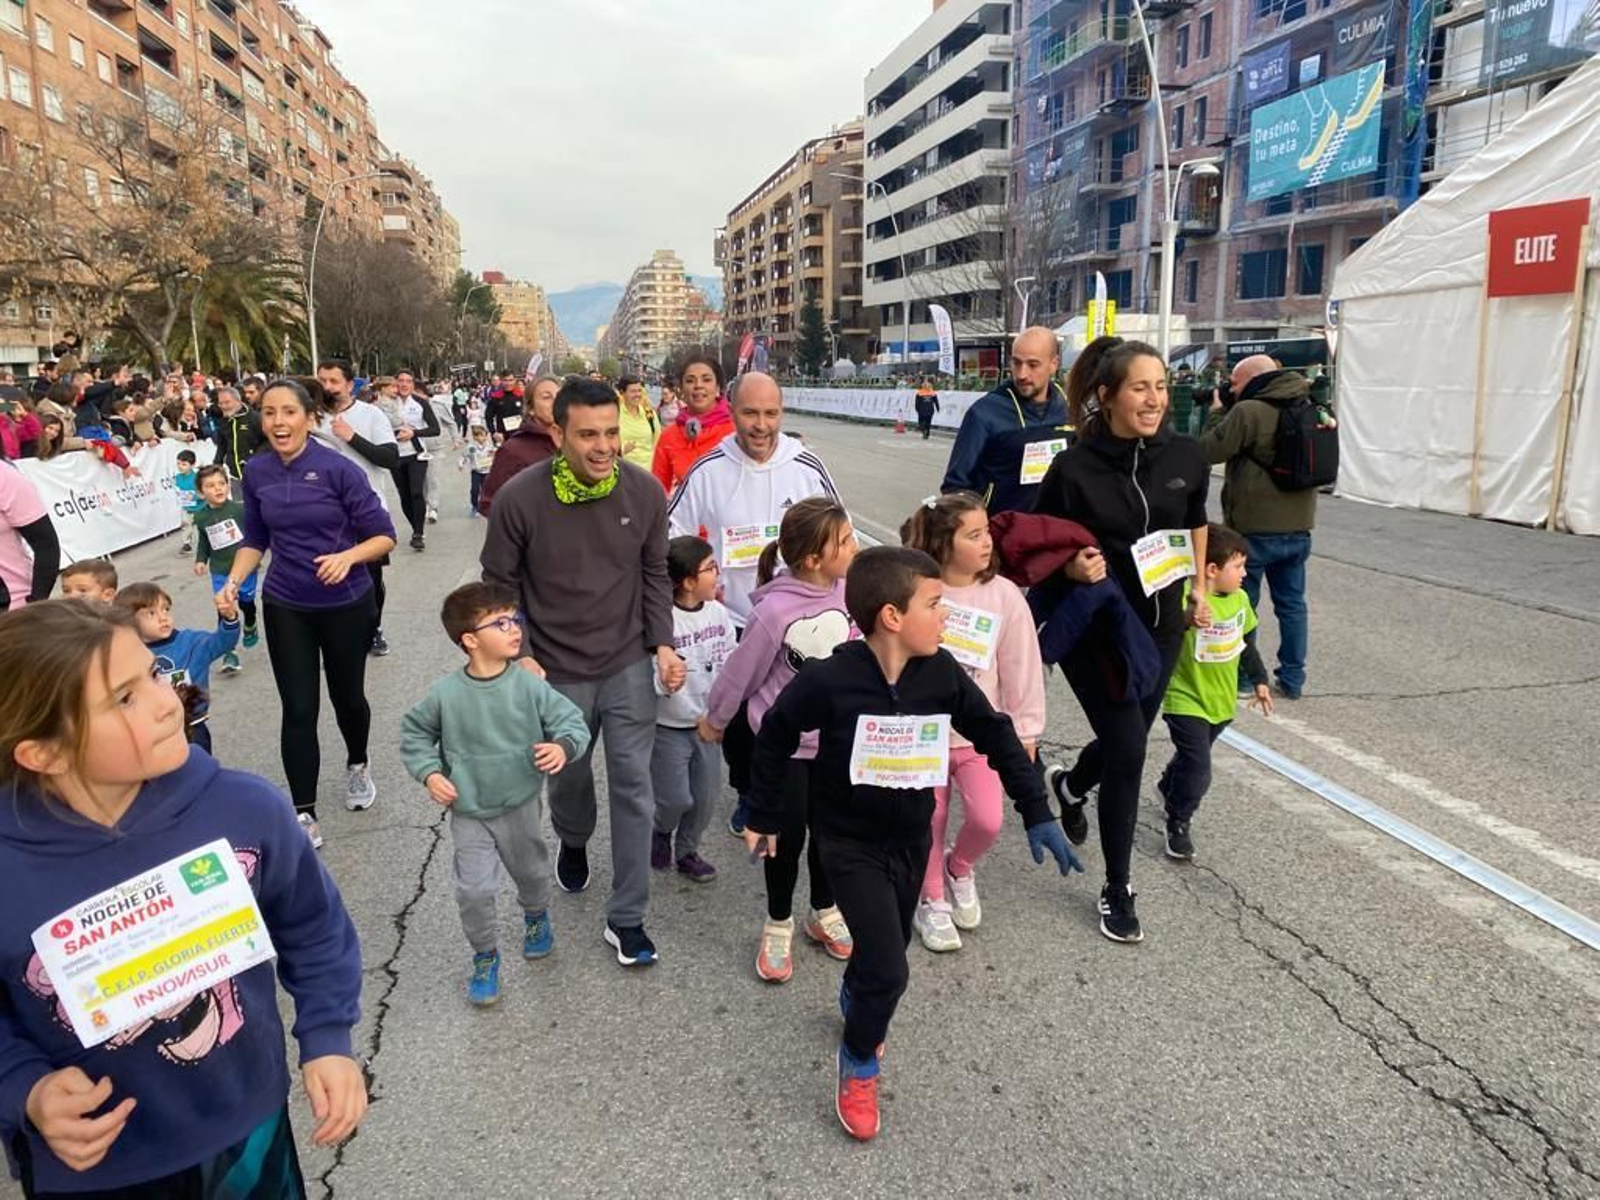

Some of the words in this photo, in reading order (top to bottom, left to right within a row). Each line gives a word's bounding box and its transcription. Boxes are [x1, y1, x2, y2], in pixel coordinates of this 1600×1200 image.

[1339, 15, 1385, 44] CULMIA
[1254, 119, 1300, 144] Destino,
[1255, 148, 1267, 162] tu
[1269, 138, 1297, 157] meta
[1341, 156, 1373, 172] CULMIA
[1514, 234, 1558, 265] ELITE
[80, 893, 141, 929] NOCHE
[144, 881, 167, 900] DE
[64, 926, 106, 956] SAN
[110, 895, 175, 936] ANTÓN
[153, 943, 204, 976] GLORIA
[206, 918, 260, 948] FUERTES
[133, 952, 231, 1009] INNOVASUR
